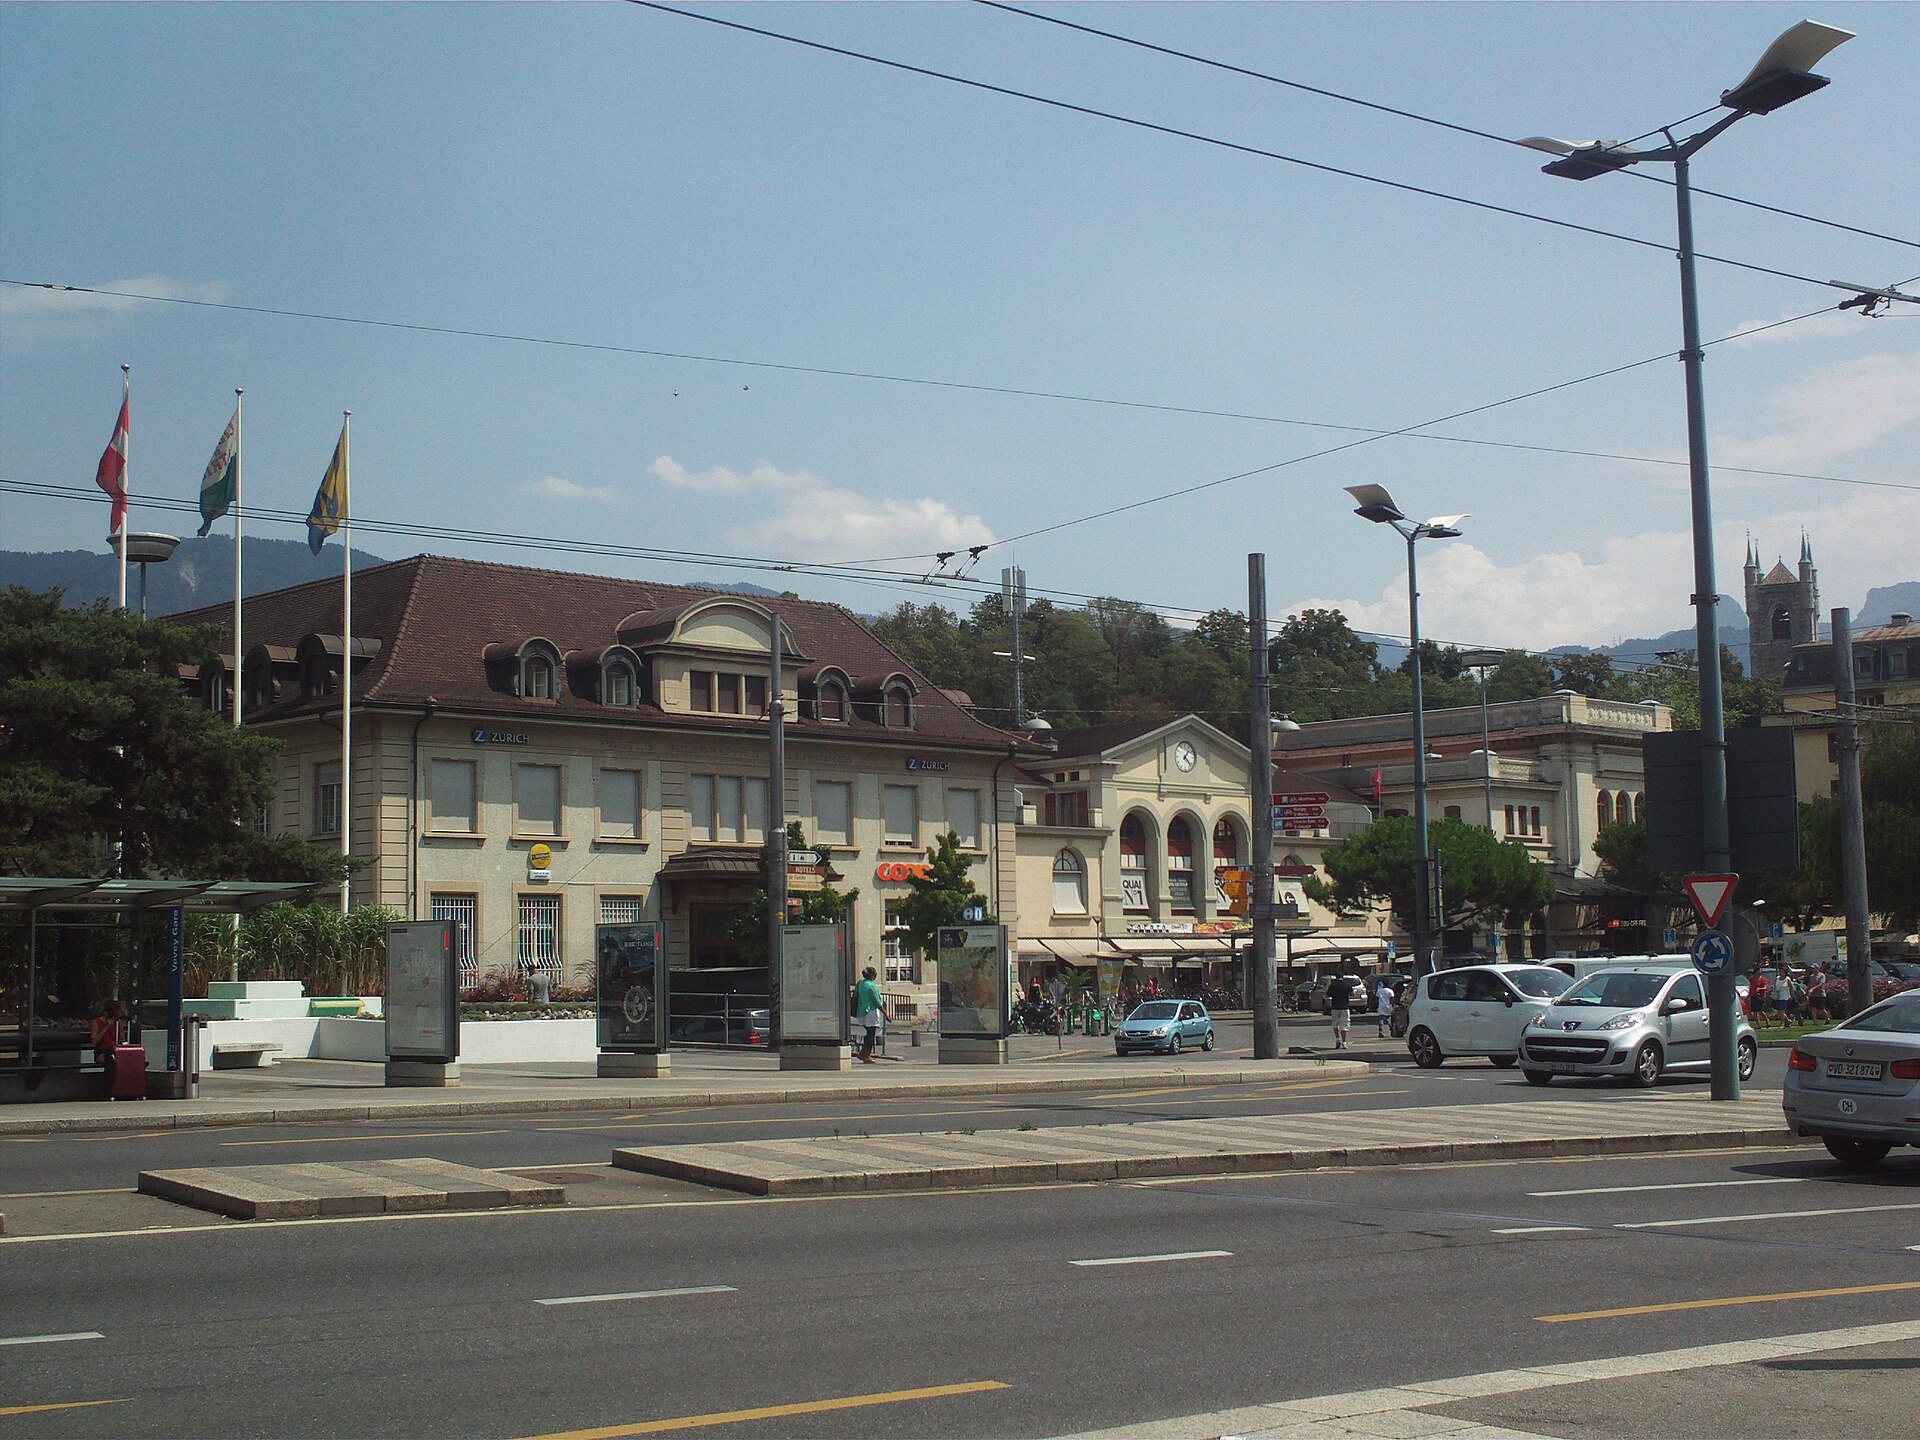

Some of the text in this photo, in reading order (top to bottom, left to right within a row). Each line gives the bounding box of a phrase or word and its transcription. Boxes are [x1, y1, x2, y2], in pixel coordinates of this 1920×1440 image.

[491, 732, 530, 744] ZURICH
[921, 760, 950, 771] ZURICH
[794, 865, 816, 874] HOTELS
[1122, 879, 1142, 890] QUAI
[171, 938, 179, 972] Vevey
[1842, 1100, 1854, 1113] CH
